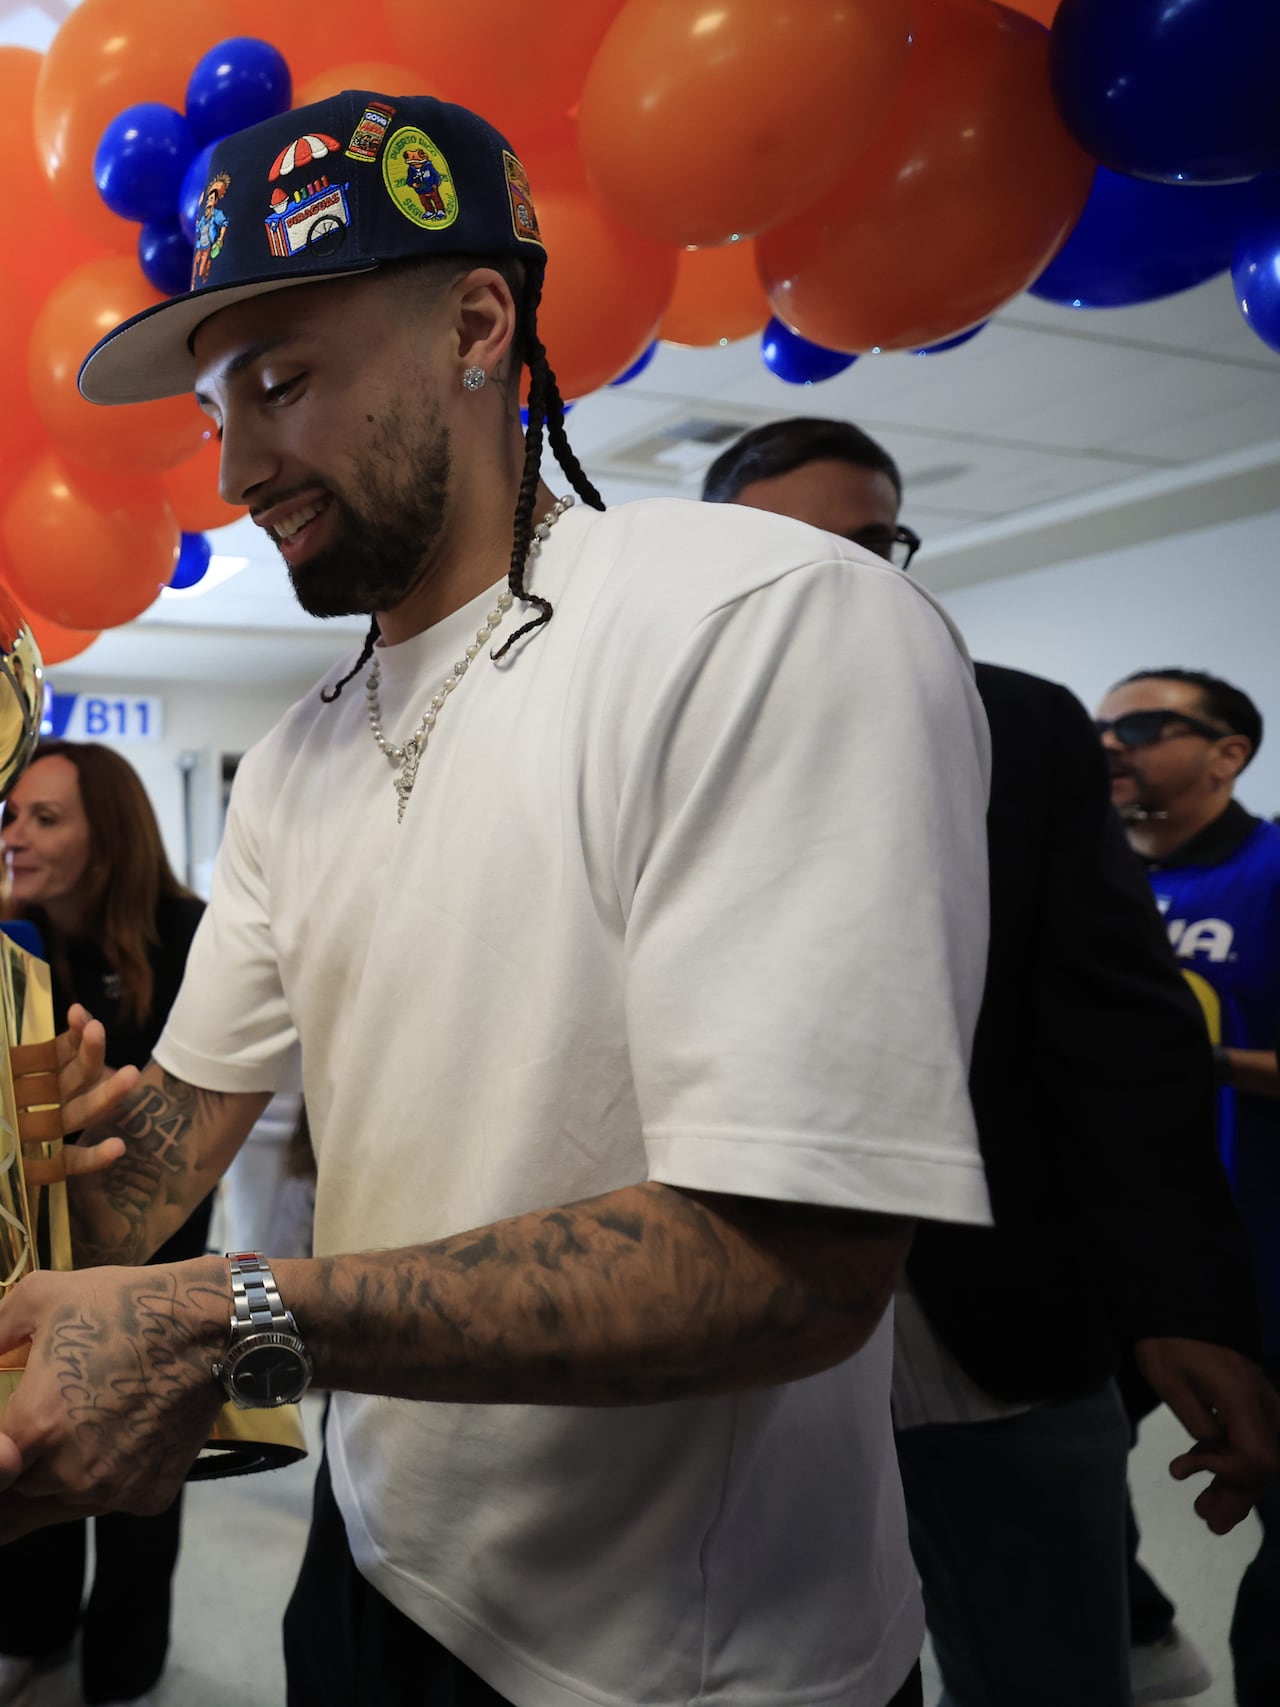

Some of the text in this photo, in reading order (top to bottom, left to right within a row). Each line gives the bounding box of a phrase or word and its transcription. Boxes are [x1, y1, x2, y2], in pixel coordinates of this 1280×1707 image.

[365, 112, 388, 126] GOYA
[391, 136, 417, 160] PUERTO
[418, 139, 437, 157] RICO
[286, 192, 341, 229] PIRAGUAS
[86, 699, 150, 736] B11
[53, 1314, 115, 1443] Uncle
